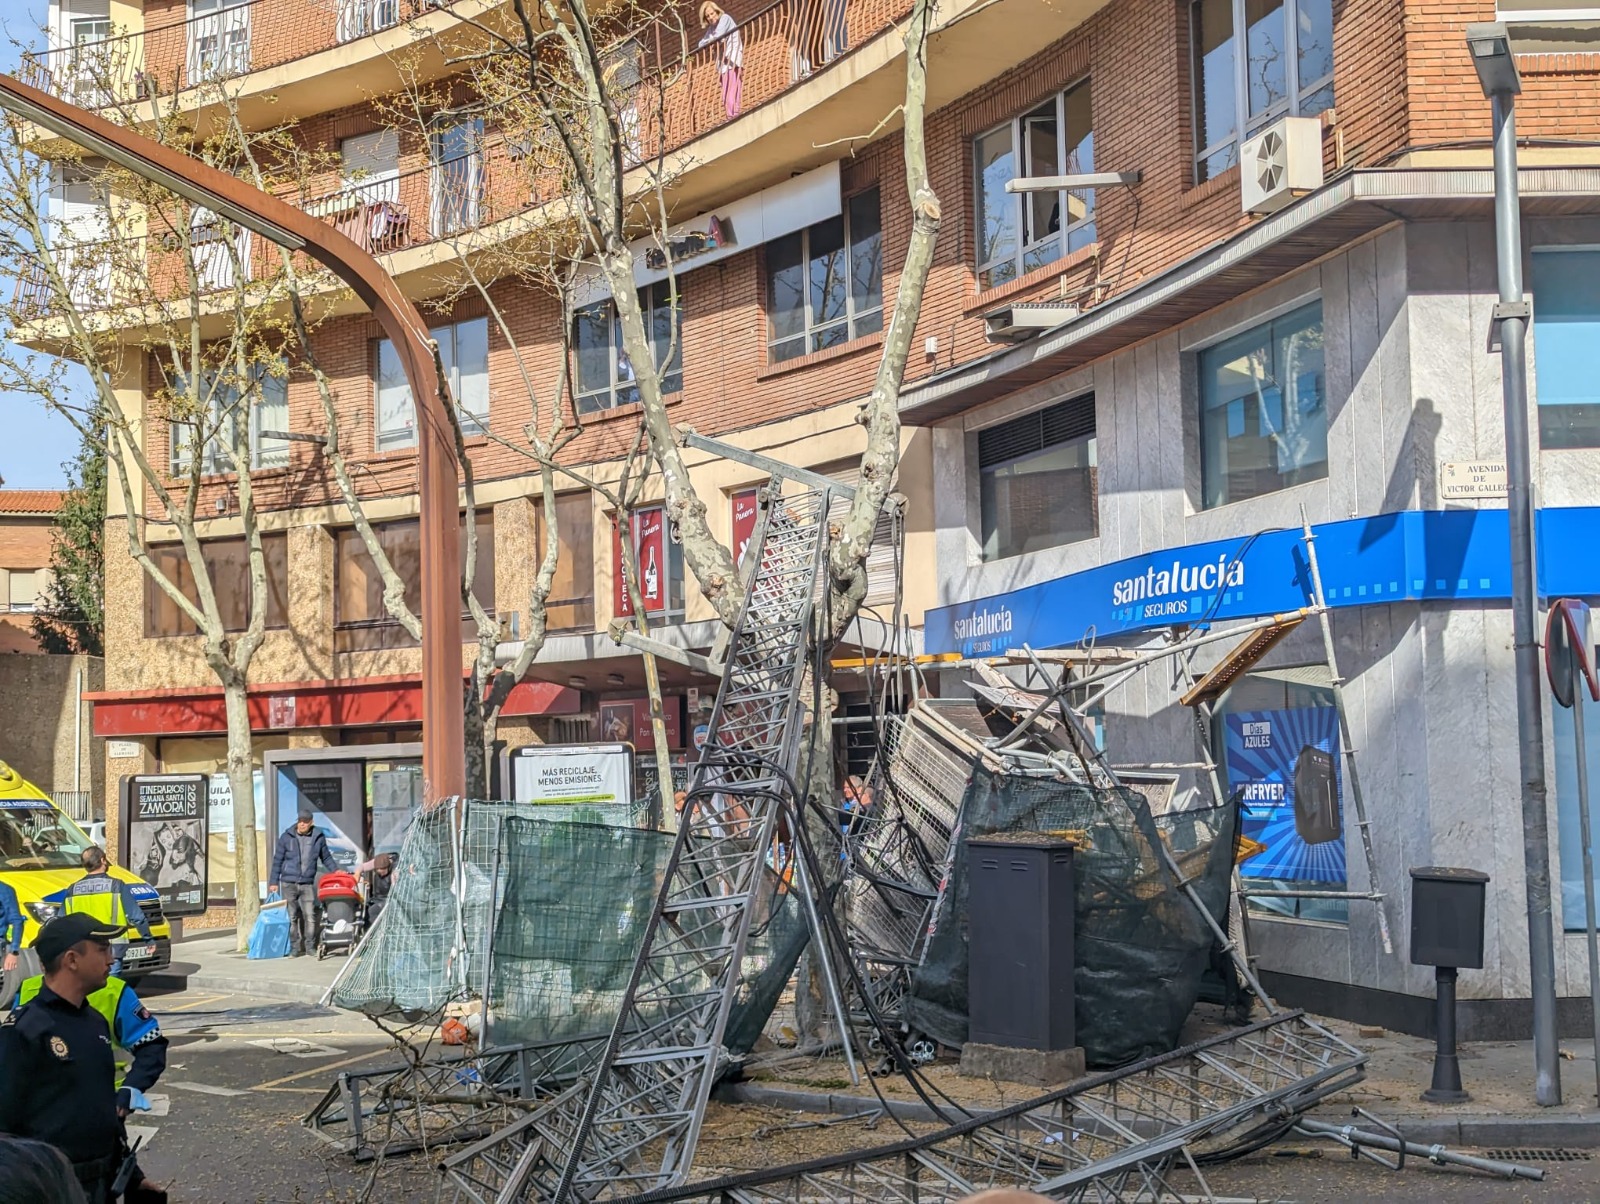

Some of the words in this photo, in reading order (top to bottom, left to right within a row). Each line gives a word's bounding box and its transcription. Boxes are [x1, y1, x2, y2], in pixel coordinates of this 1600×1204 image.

[1467, 465, 1506, 473] AVENIDA
[1473, 475, 1486, 483] DE
[1447, 485, 1475, 493] VICTOR
[1478, 484, 1508, 492] GALLEG
[1113, 554, 1244, 606] santalucía
[1144, 600, 1188, 618] SEGUROS
[954, 604, 1012, 640] santalucía
[1249, 723, 1264, 735] Días
[1244, 735, 1271, 748] AZULES
[542, 766, 558, 777] MÁS
[538, 776, 563, 786] MENOS
[140, 784, 185, 795] ITINERARIOS
[140, 794, 165, 803] SEMANA
[165, 793, 185, 802] SANTA
[187, 784, 197, 816] 2023
[140, 801, 185, 815] ZAMORA
[74, 883, 111, 894] POLICIA
